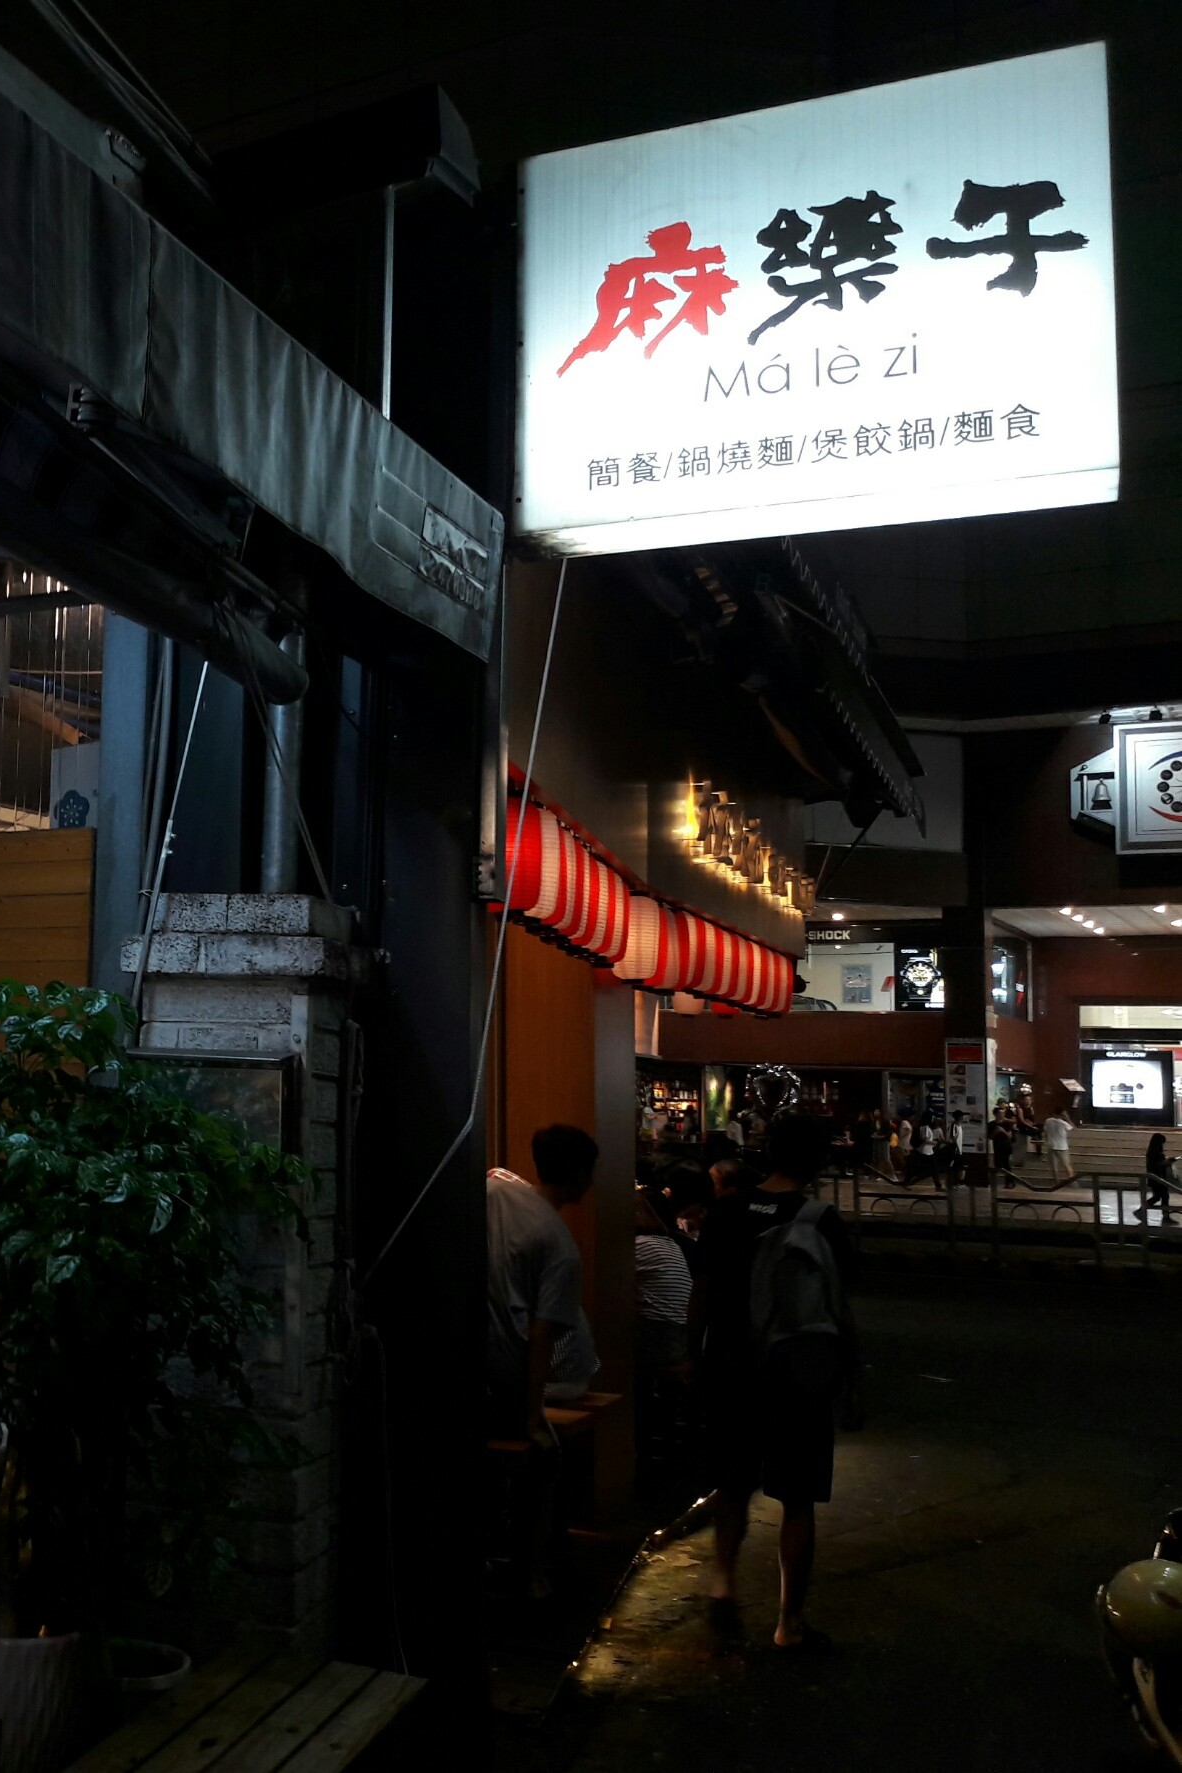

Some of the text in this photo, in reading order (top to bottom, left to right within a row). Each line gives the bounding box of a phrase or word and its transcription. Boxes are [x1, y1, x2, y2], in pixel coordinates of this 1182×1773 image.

[557, 179, 1090, 377] 麻樂子
[704, 333, 919, 402] Má lè zi
